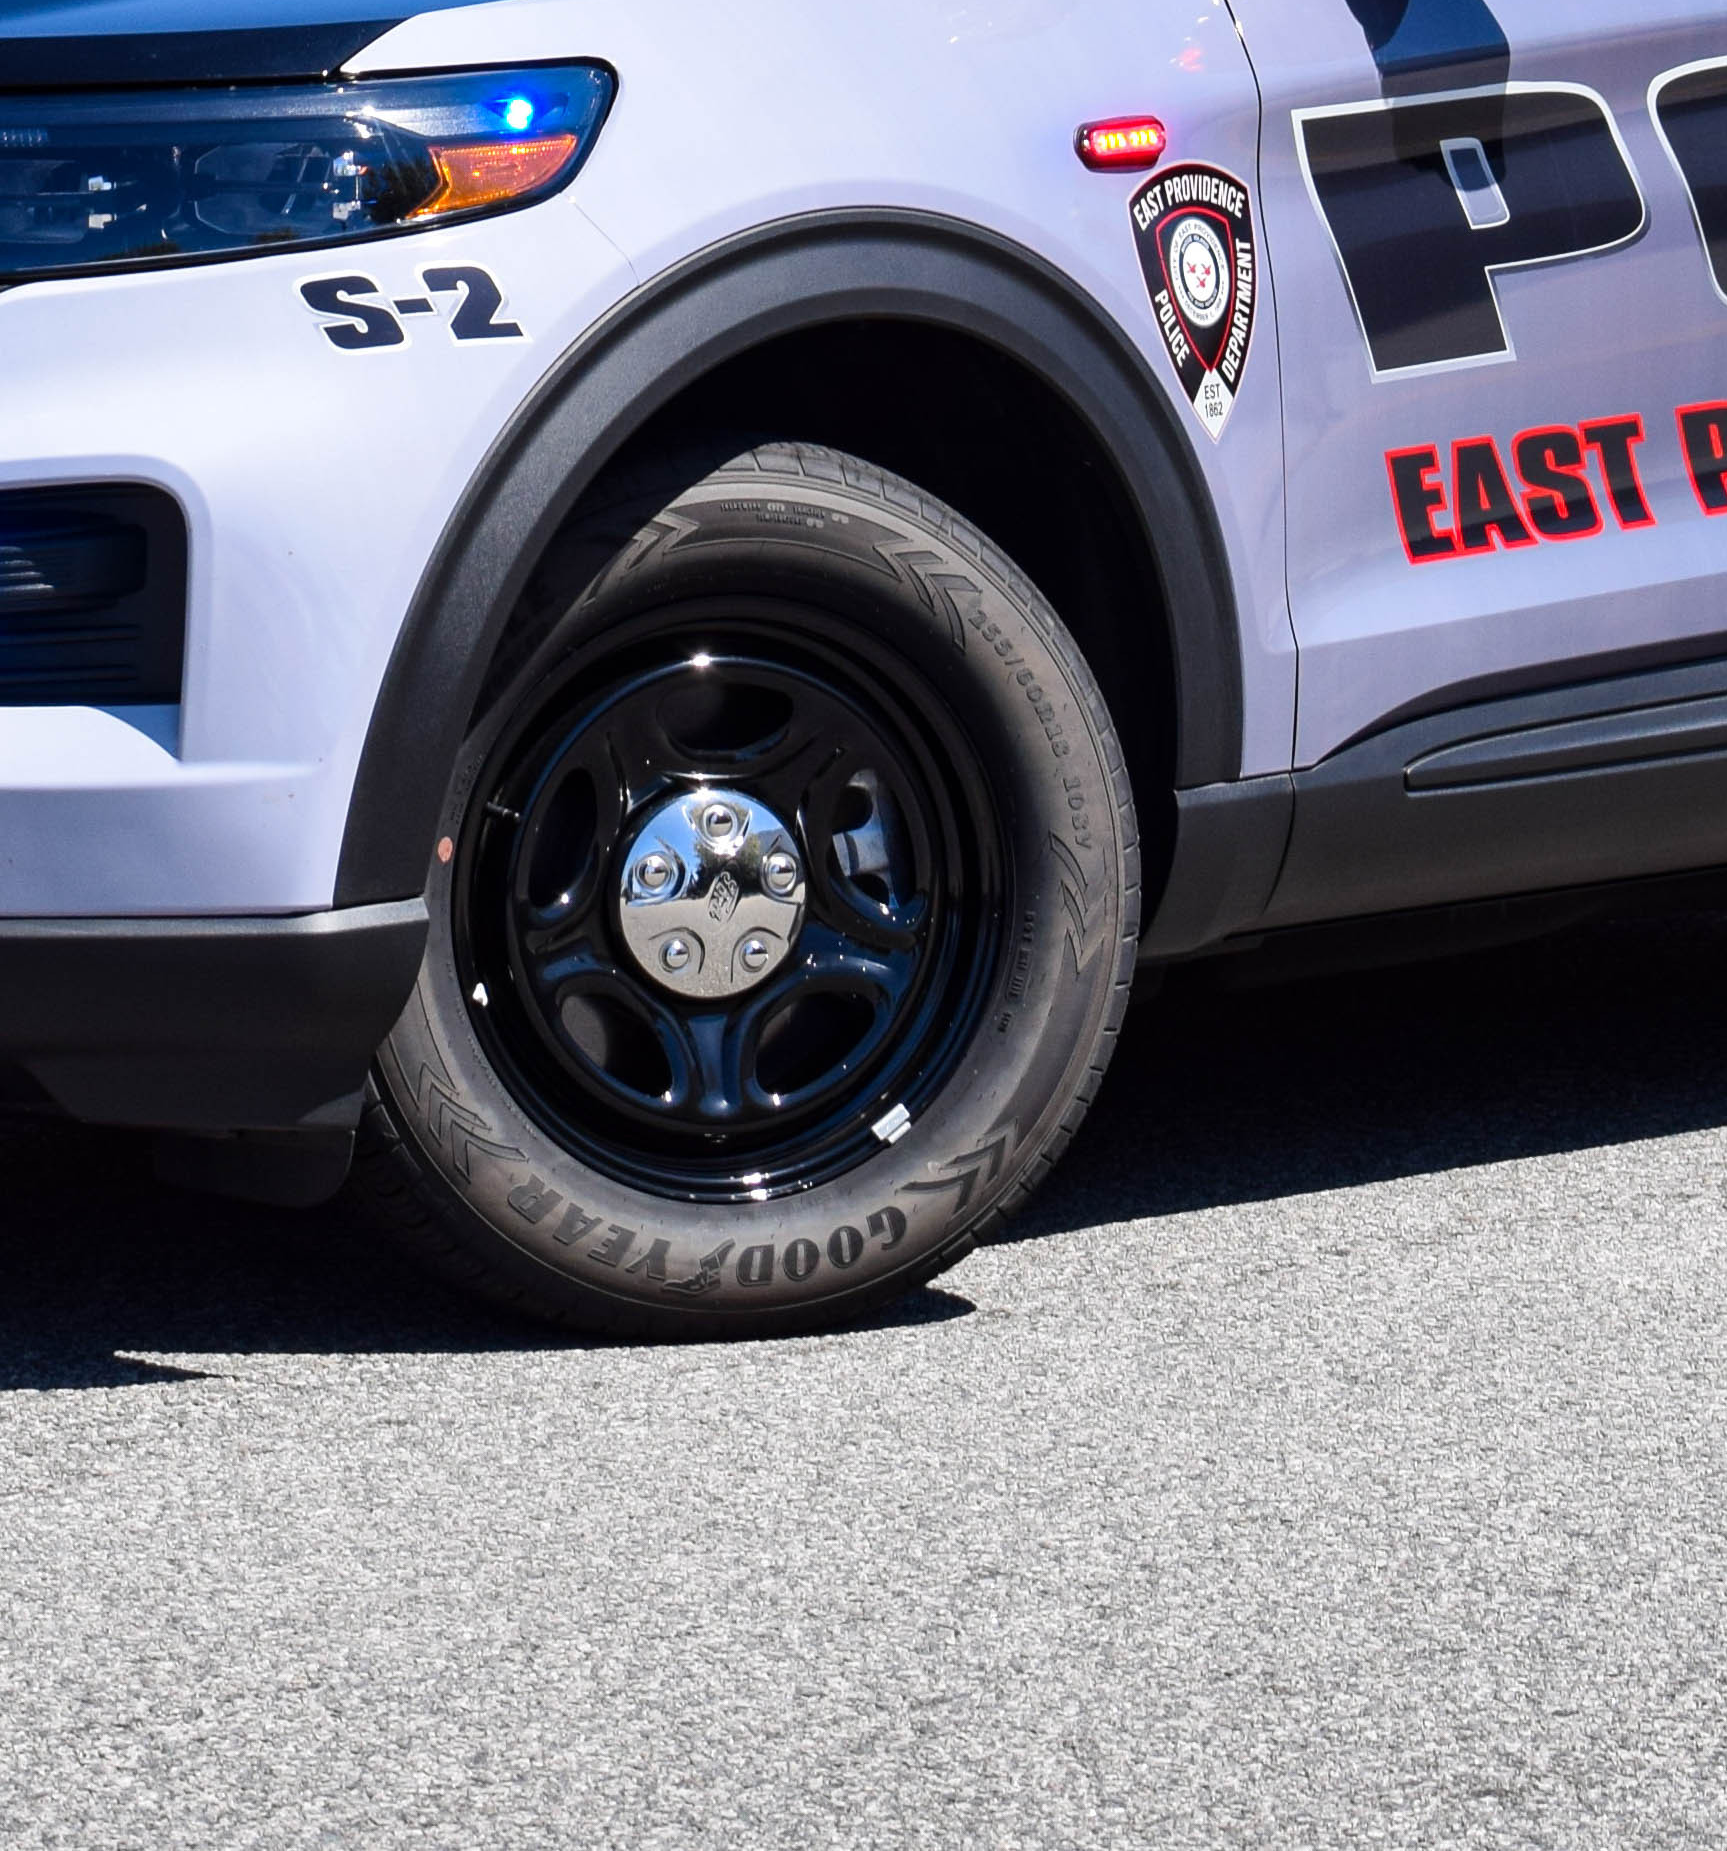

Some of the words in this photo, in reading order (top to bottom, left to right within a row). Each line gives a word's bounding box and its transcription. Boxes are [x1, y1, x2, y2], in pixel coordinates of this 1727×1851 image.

[1133, 184, 1165, 231] EAST
[1164, 174, 1245, 218] PROVIDENCE
[294, 260, 533, 355] S-2
[1155, 288, 1190, 367] POLICE
[1221, 238, 1253, 383] DEPARTMENT
[1204, 383, 1221, 400] EST
[1204, 402, 1223, 418] 1862
[1384, 413, 1657, 565] EAST
[506, 1172, 908, 1289] GOODYEAR
